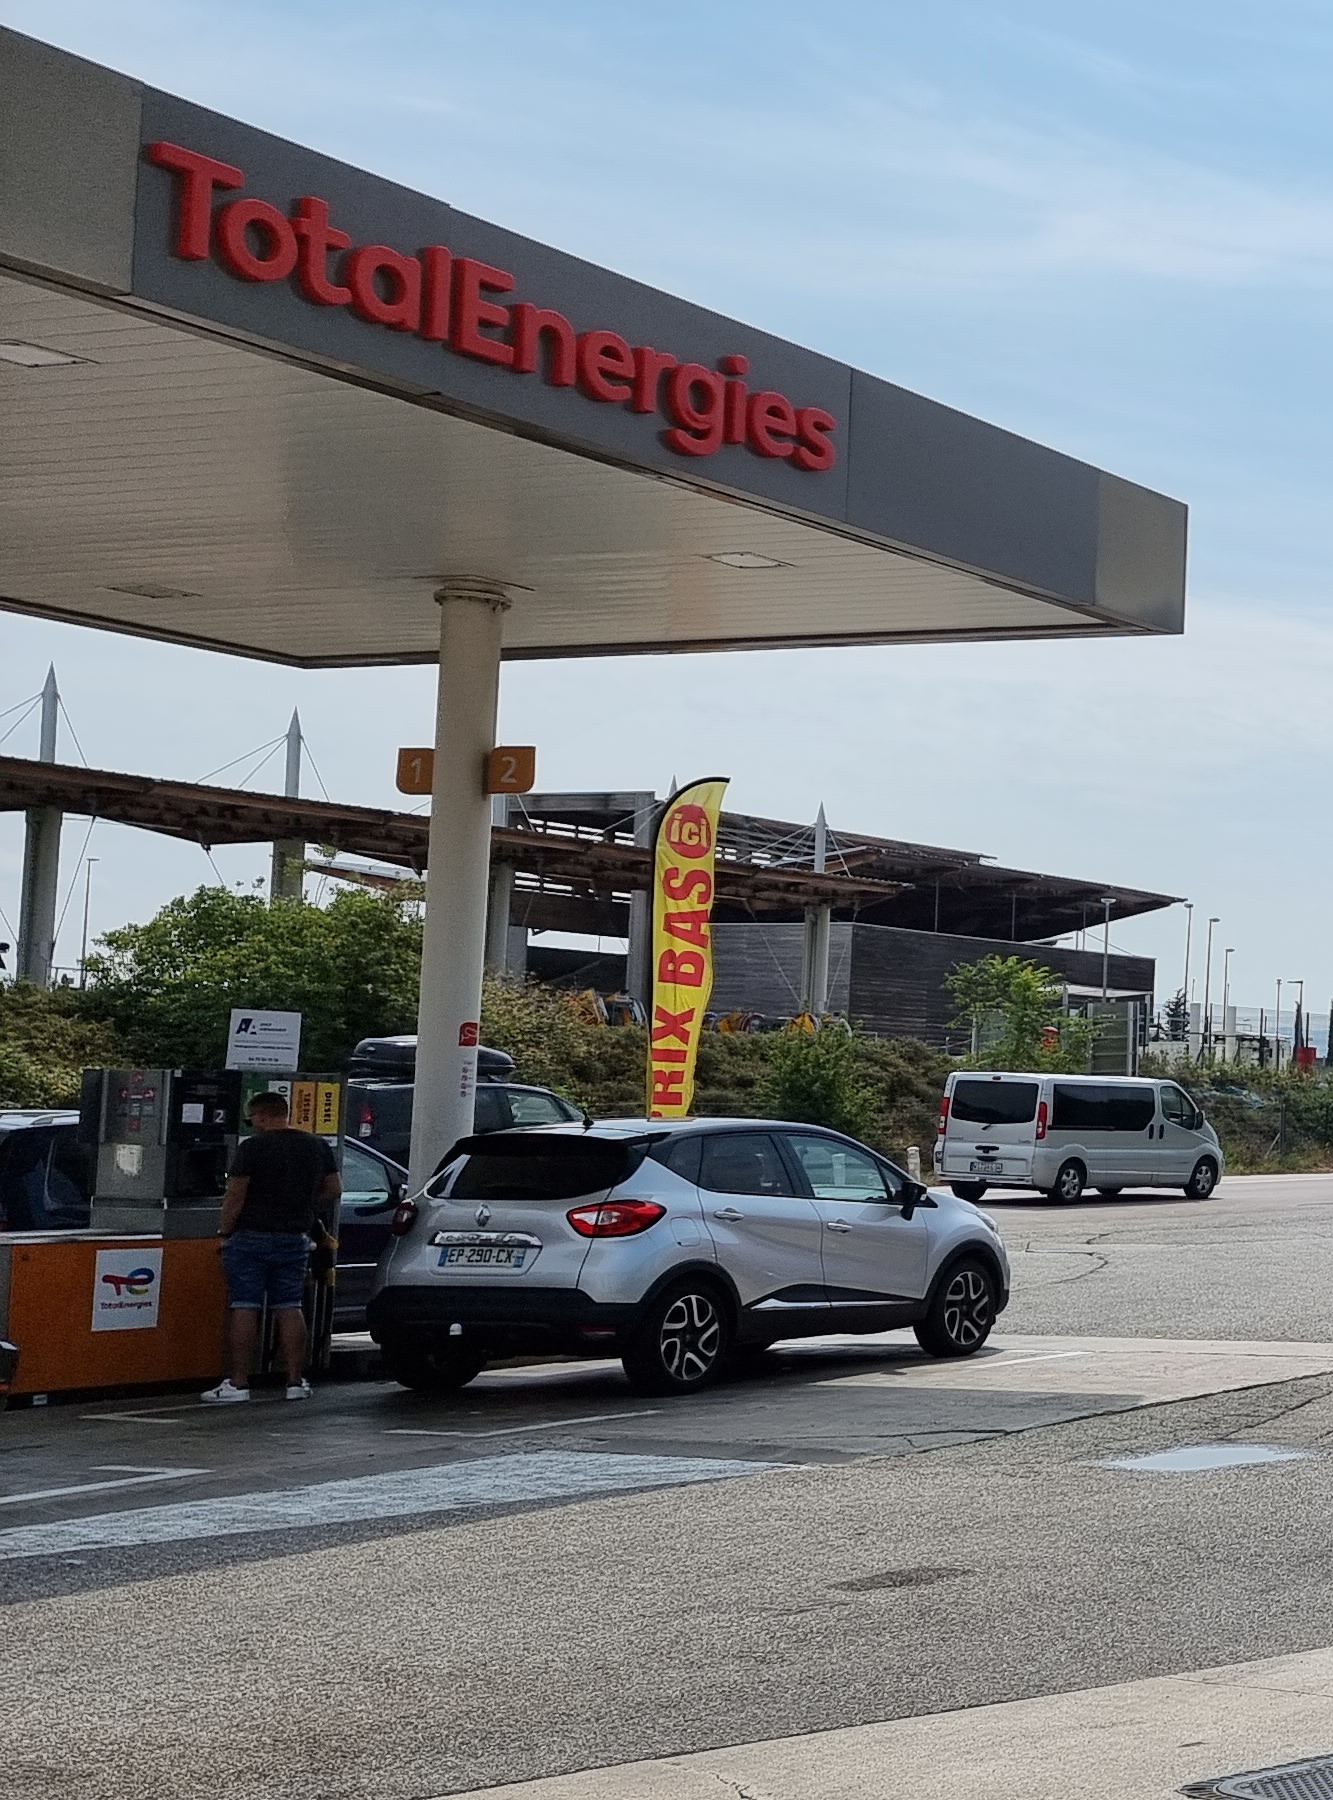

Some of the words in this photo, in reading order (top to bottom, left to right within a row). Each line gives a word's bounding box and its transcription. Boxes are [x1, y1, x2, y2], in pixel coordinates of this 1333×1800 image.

[149, 141, 836, 471] TotalEnergies
[411, 757, 422, 784] 1
[501, 756, 517, 783] 2
[670, 813, 709, 848] ici
[658, 867, 711, 987] BAS
[651, 1005, 695, 1117] RIX
[215, 1110, 224, 1123] 2
[324, 1092, 332, 1123] DIESEL
